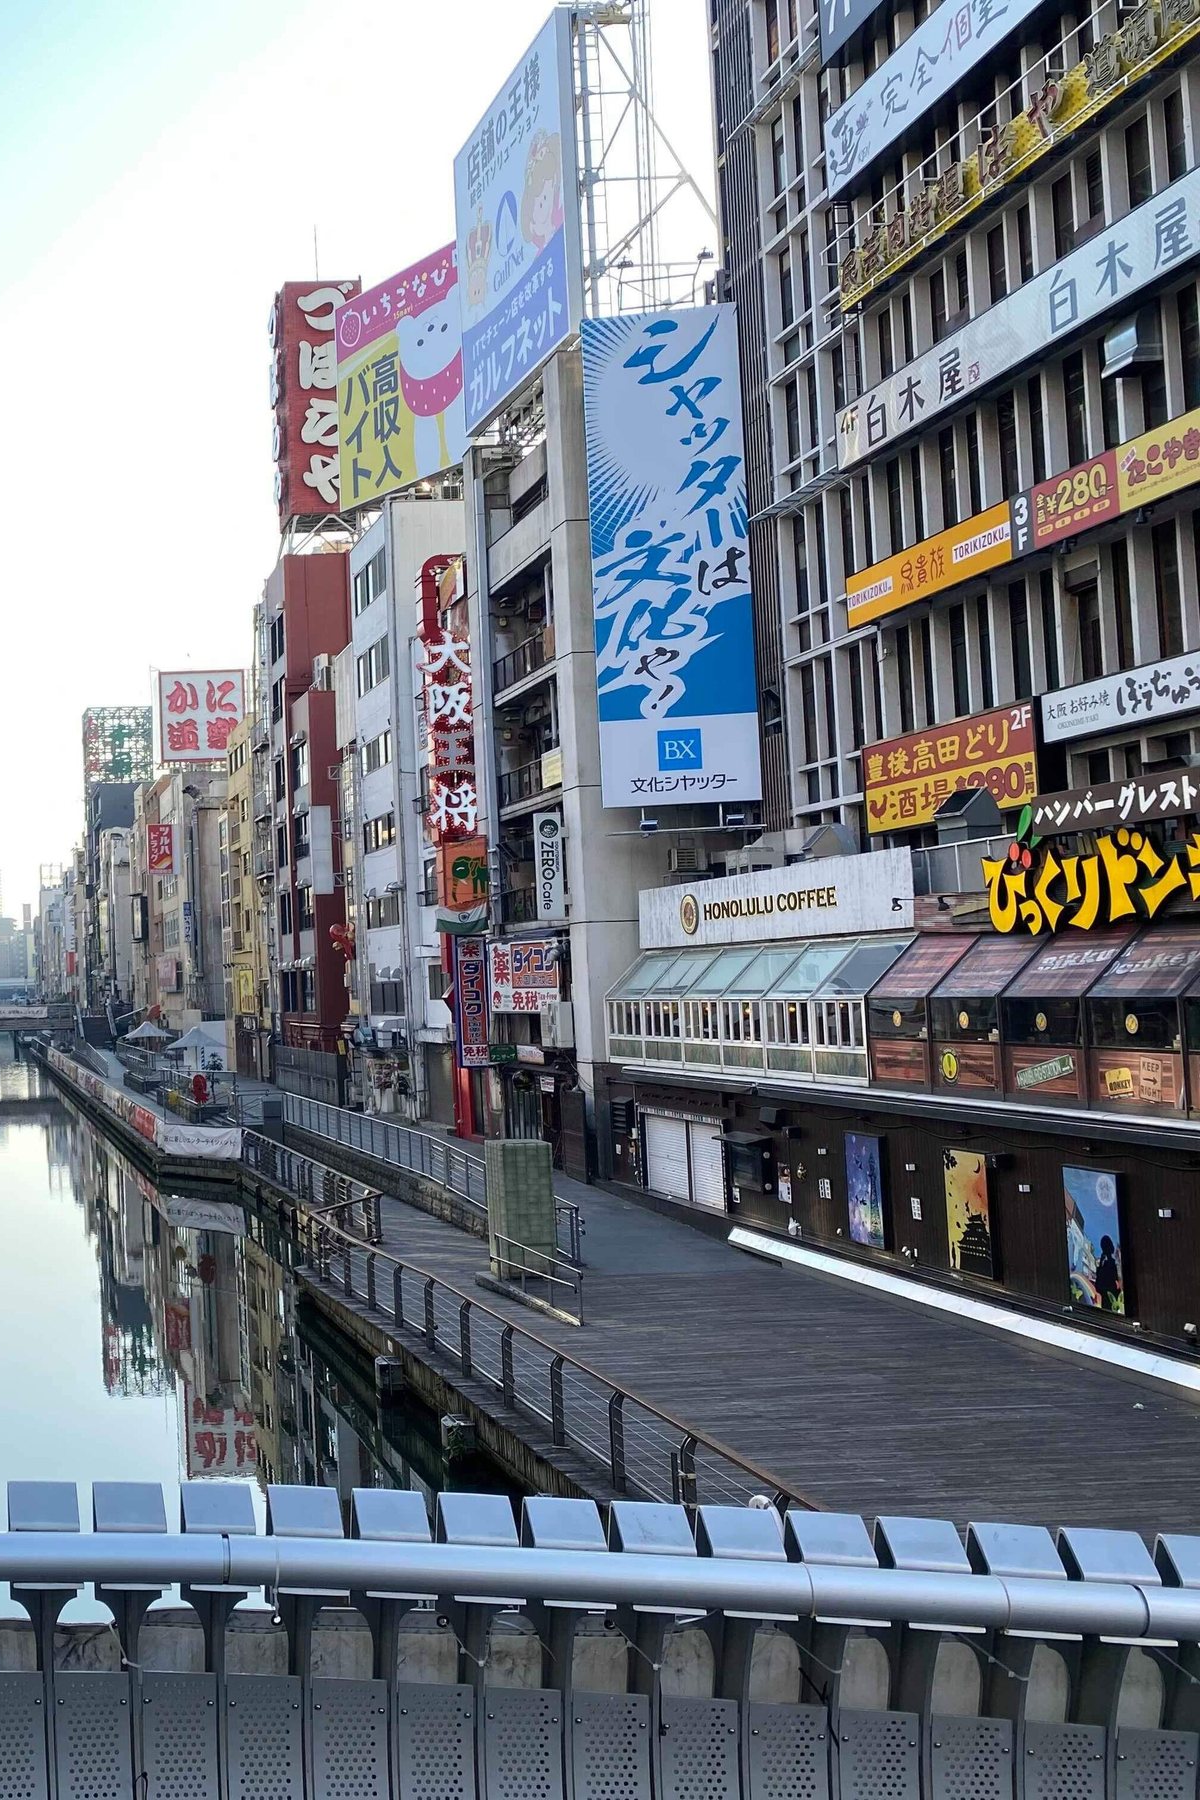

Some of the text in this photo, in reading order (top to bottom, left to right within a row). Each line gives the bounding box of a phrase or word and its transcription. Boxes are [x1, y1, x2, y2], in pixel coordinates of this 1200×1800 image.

[467, 52, 541, 190] 店舗の王様
[1048, 196, 1194, 335] 白木屋
[362, 258, 449, 326] いちごなび
[469, 286, 562, 417] ガルフネット
[866, 346, 966, 448] 白木屋
[344, 364, 373, 499] バイト
[371, 351, 403, 488] 高収入
[622, 309, 748, 596] シャッターは
[1015, 496, 1029, 551] 3F
[1036, 493, 1047, 524] 全品
[953, 526, 1005, 561] TORIKIZOKU
[900, 545, 946, 596] 鳥貴族
[848, 580, 888, 608] TORIKIZOKU
[166, 680, 238, 715] かに
[1046, 699, 1068, 721] 大阪
[1069, 689, 1112, 713] お好み焼
[414, 629, 478, 833] 大阪王将
[1011, 704, 1032, 731] 2F
[663, 740, 697, 762] BX
[866, 717, 1010, 783] 豊後高田どり
[150, 831, 160, 863] ドラッグ
[159, 826, 171, 856] ツルハ
[541, 841, 556, 881] ZERO
[704, 885, 838, 921] HONOLULU COFFEE
[462, 962, 483, 1016] ダイコク
[512, 990, 539, 1011] 免税
[463, 1046, 487, 1057] 免税
[1142, 1060, 1161, 1073] KEEP
[1140, 1084, 1162, 1099] RIGHT
